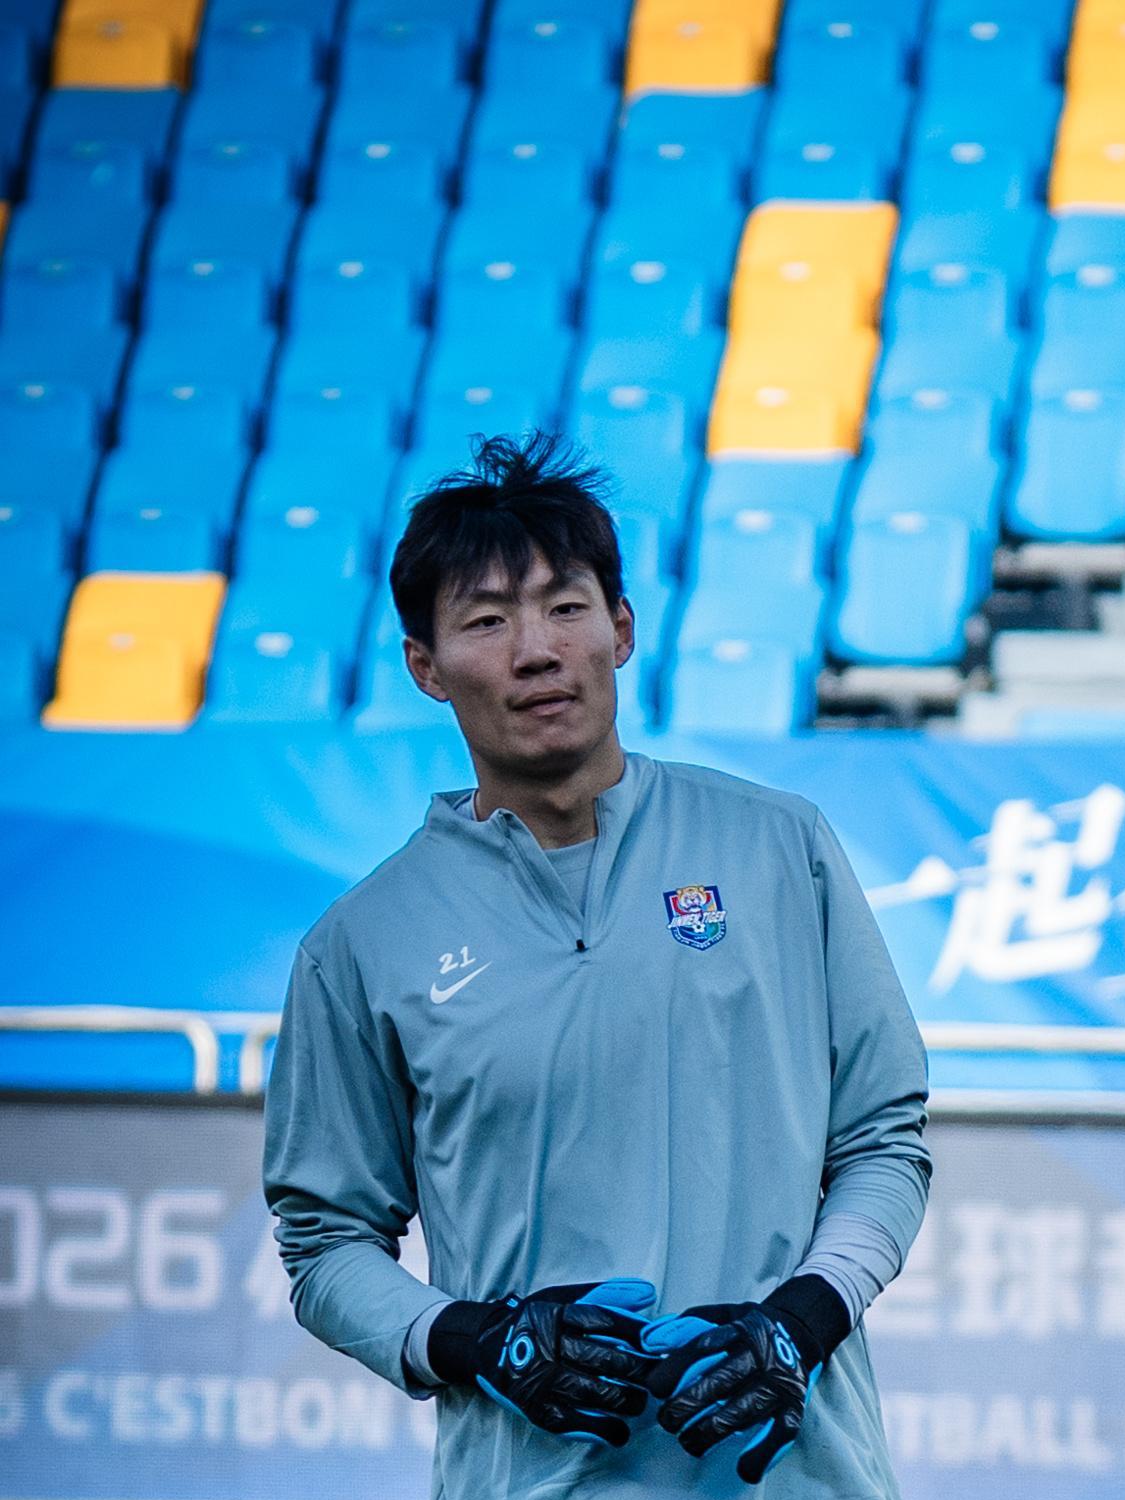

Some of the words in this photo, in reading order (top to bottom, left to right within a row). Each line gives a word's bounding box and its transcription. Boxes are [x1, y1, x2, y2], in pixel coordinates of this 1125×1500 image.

[439, 945, 476, 974] 21
[44, 1373, 398, 1447] C'ESTBON
[882, 1393, 1112, 1468] TBALL
